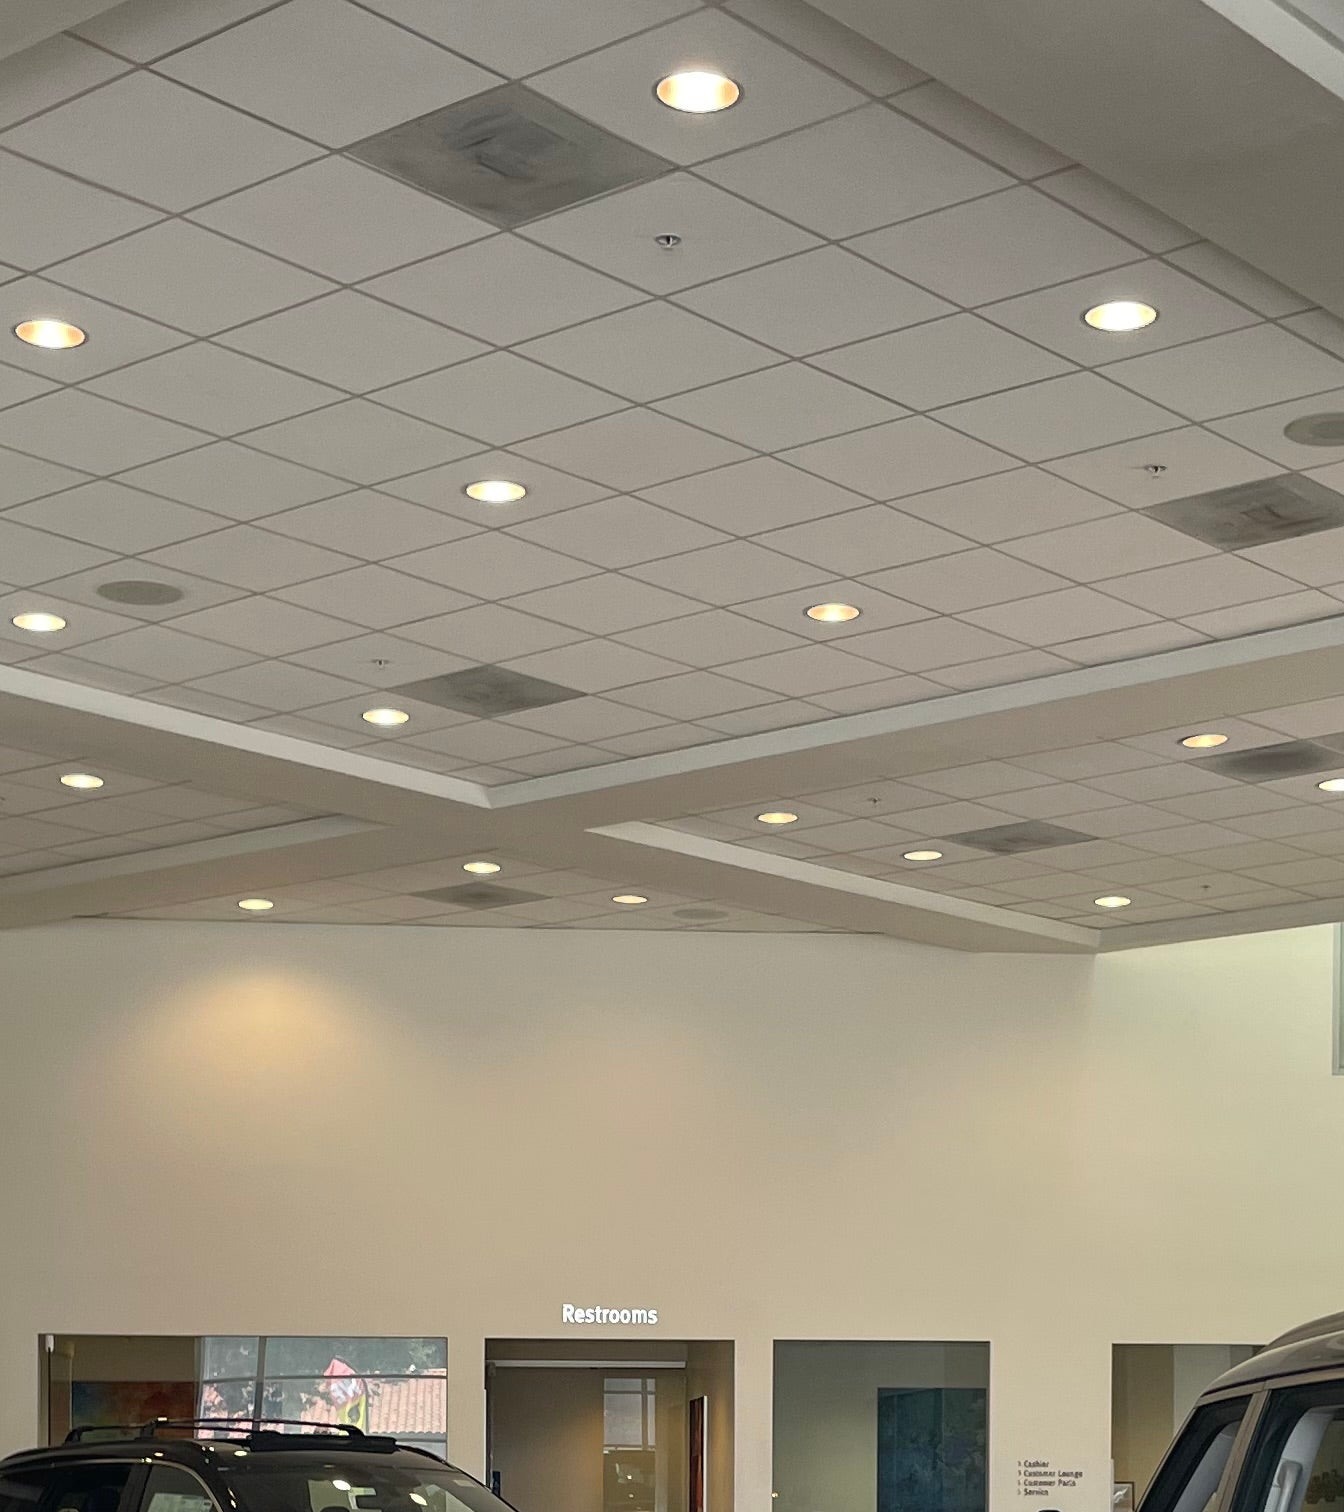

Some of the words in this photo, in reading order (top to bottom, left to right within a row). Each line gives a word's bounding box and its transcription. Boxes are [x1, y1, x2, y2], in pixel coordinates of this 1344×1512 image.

[562, 1303, 658, 1325] Restrooms
[1023, 1460, 1049, 1468] Cashier
[1023, 1469, 1056, 1477] Customer
[1057, 1470, 1083, 1479] Lounge
[1023, 1478, 1056, 1487] Customer
[1023, 1487, 1049, 1496] Service
